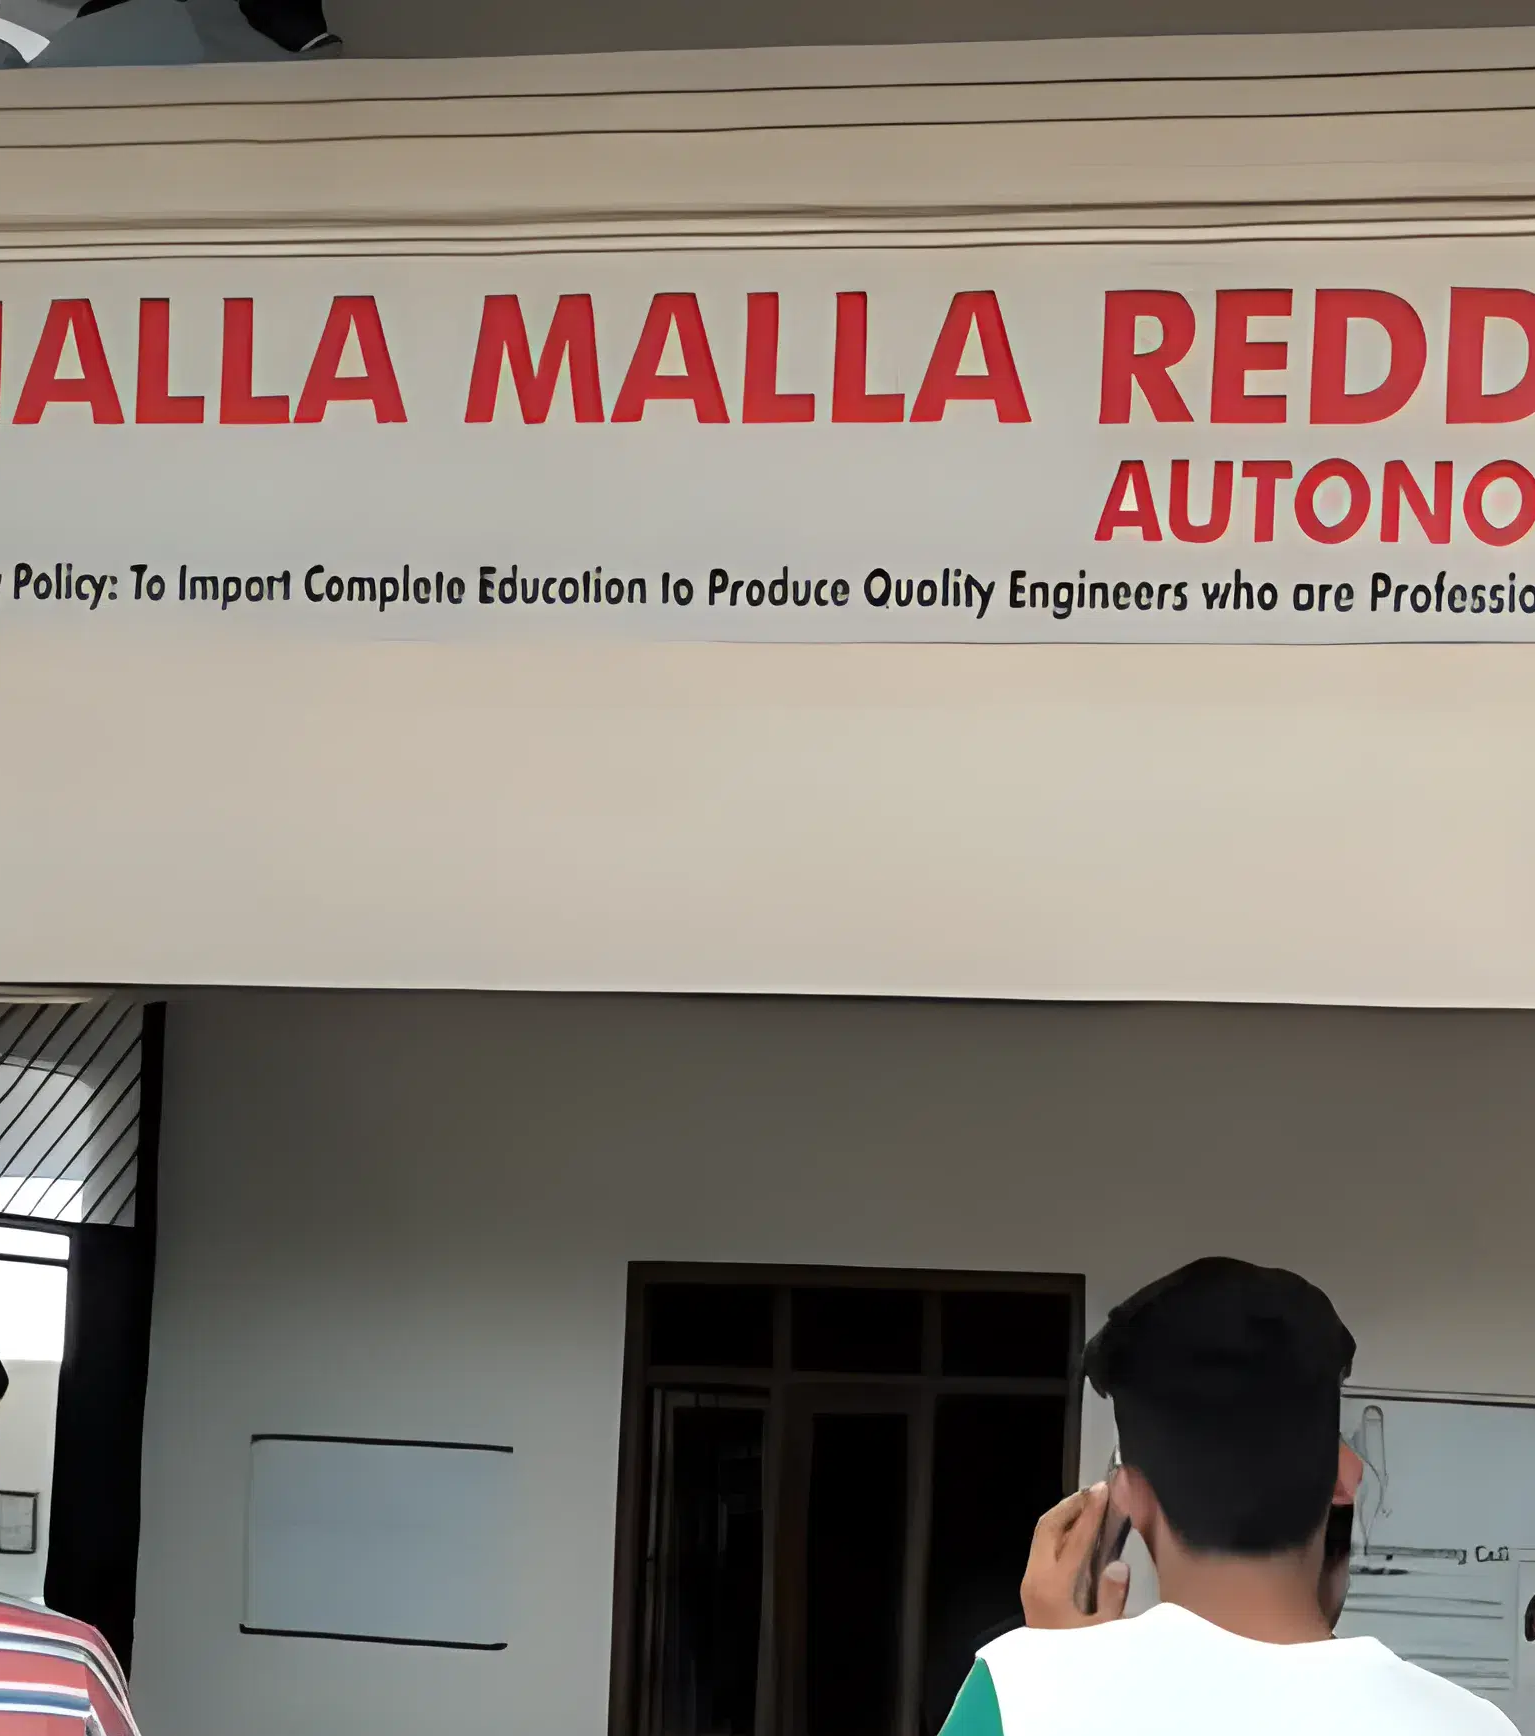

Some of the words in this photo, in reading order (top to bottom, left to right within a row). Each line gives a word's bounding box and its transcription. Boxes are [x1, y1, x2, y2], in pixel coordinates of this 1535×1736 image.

[465, 292, 1032, 424] MALLA
[14, 563, 117, 610] Policy:
[130, 564, 165, 601] To
[305, 564, 465, 612] Complete
[479, 565, 646, 604] Education
[662, 570, 693, 606] to
[709, 566, 849, 606] Produce
[864, 568, 995, 619] Quality
[1010, 570, 1187, 619] Engineers
[1202, 569, 1278, 610] who
[1293, 583, 1354, 612] are
